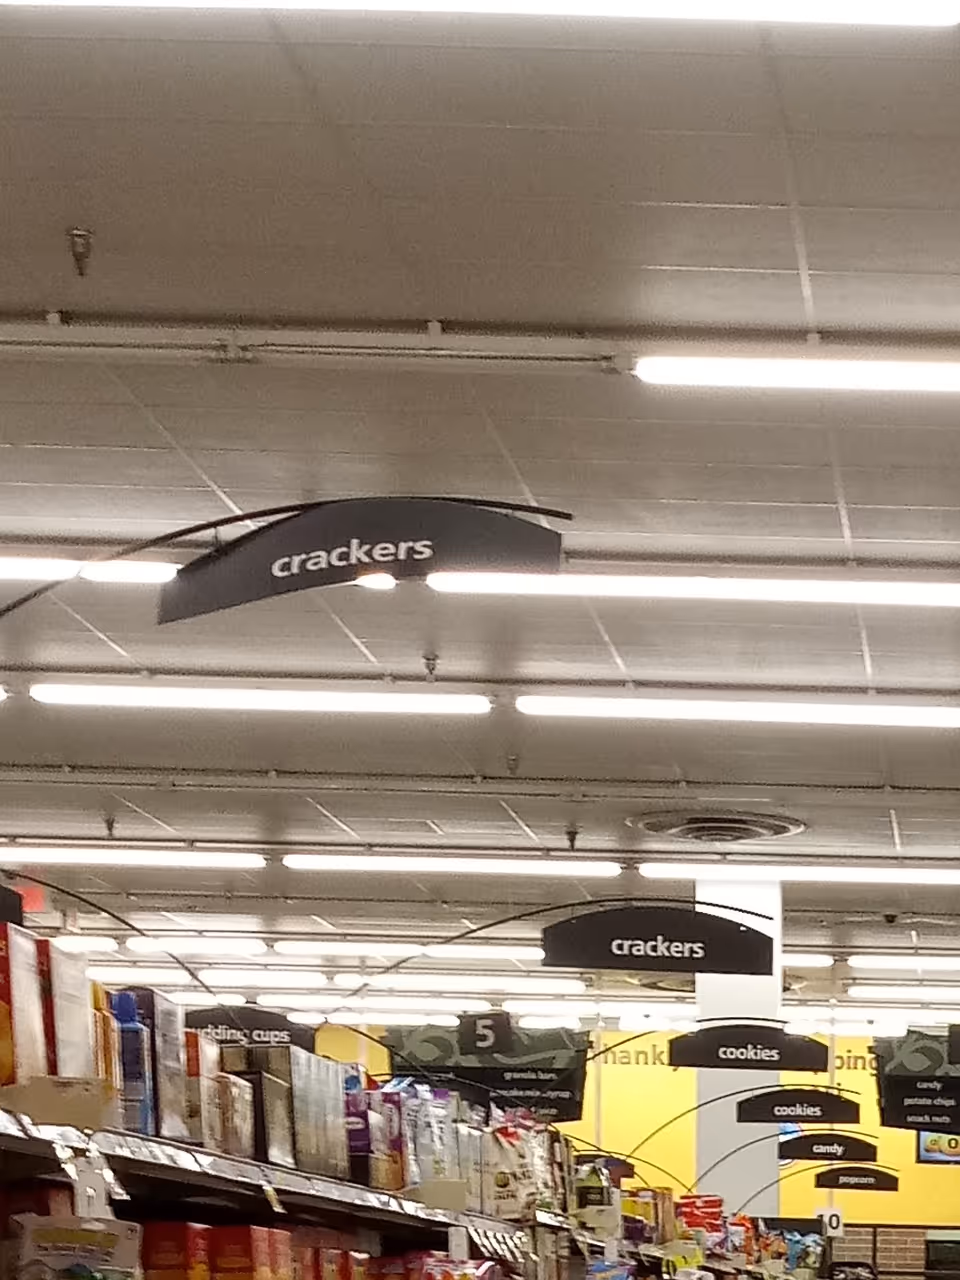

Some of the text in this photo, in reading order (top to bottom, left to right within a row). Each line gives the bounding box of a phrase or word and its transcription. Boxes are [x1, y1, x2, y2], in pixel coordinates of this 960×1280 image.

[271, 538, 434, 578] crackers
[610, 936, 705, 959] crackers
[252, 1029, 292, 1046] cups
[475, 1019, 496, 1048] 5
[718, 1044, 780, 1061] cookies
[916, 1080, 943, 1090] candy
[773, 1103, 822, 1117] cookies
[812, 1143, 844, 1156] candy
[838, 1174, 876, 1186] popcorn
[817, 1213, 841, 1230] 10
